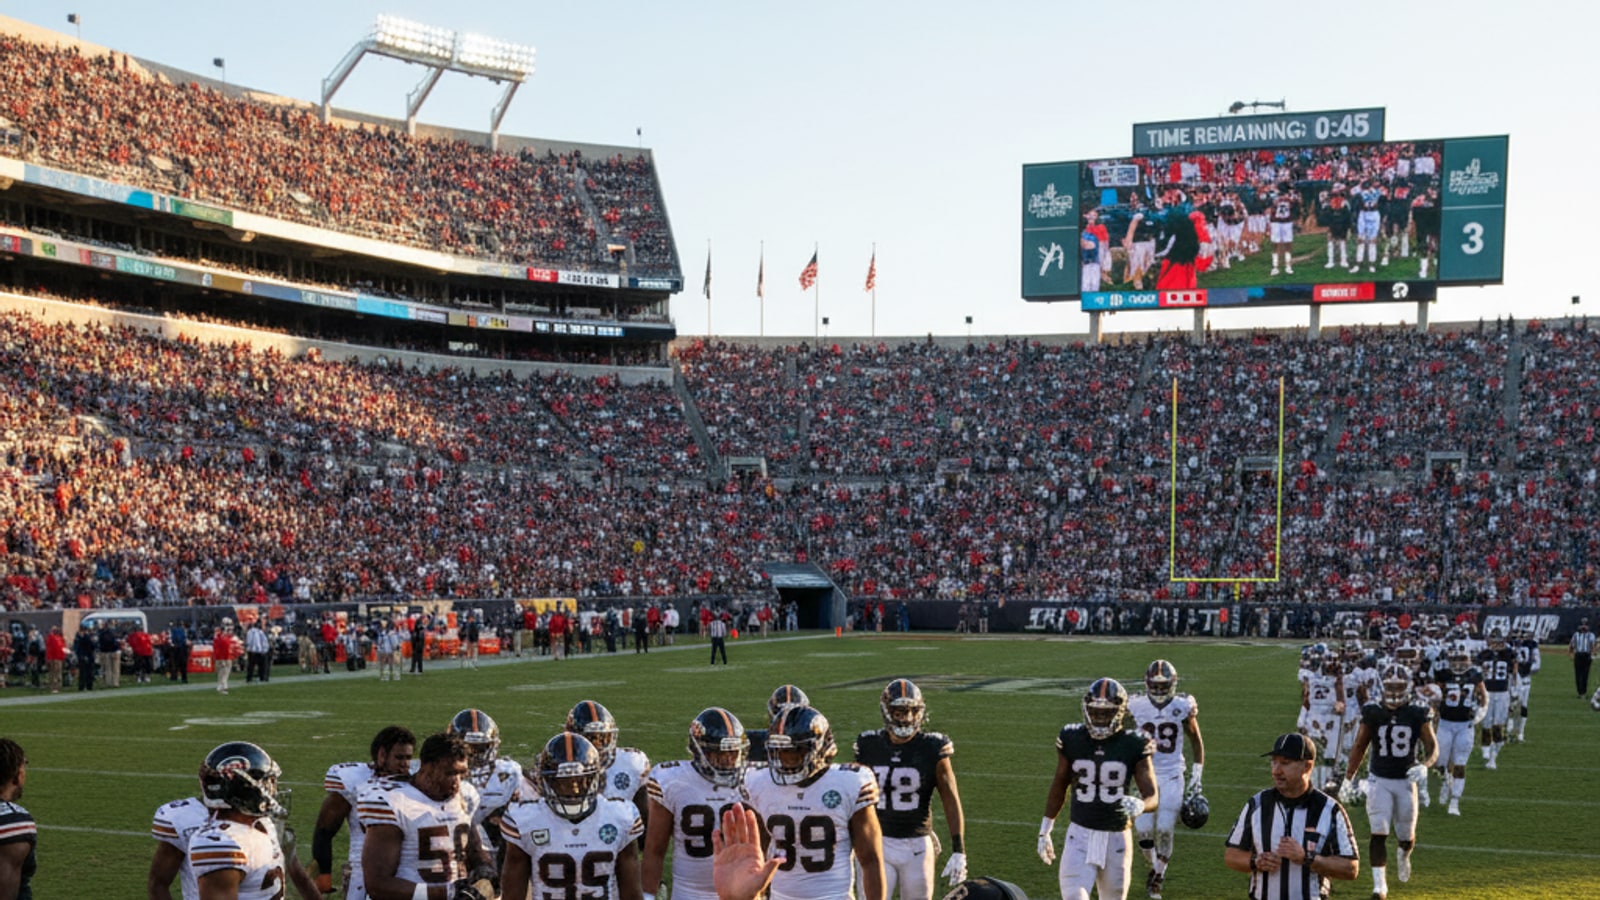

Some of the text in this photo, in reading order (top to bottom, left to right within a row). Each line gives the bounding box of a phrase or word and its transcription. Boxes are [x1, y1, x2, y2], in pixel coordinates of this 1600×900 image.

[1147, 127, 1191, 148] TIME
[1315, 113, 1370, 140] 0:45
[1461, 222, 1484, 255] 3
[1377, 725, 1412, 758] 18
[1072, 759, 1127, 804] 38
[767, 814, 837, 873] 39
